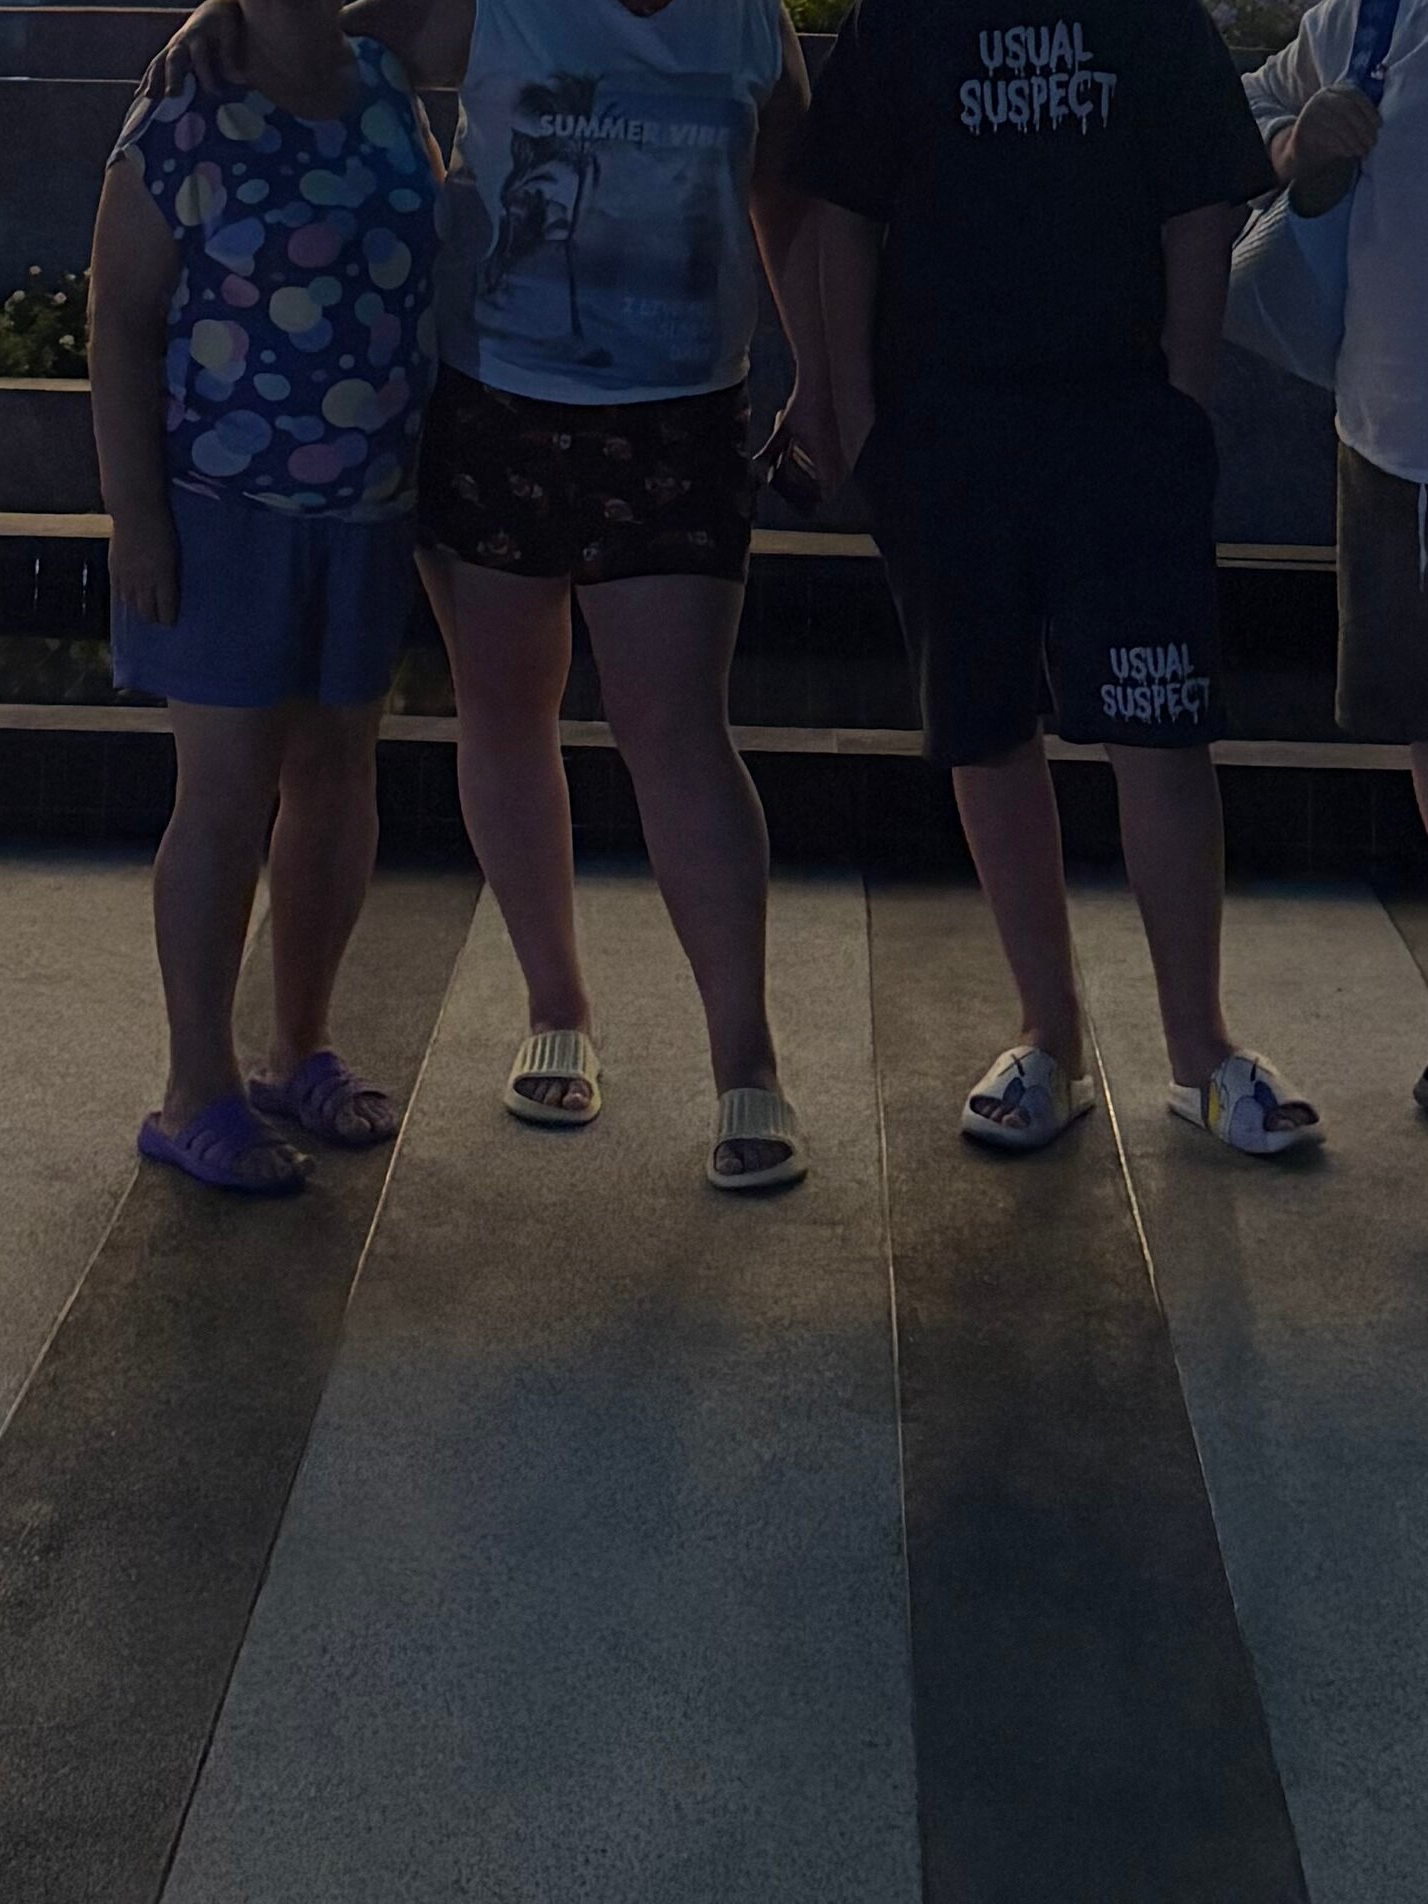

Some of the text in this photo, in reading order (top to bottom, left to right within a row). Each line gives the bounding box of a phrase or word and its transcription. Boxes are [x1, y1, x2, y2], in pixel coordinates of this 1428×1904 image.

[979, 19, 1093, 76] USUAL
[960, 72, 1117, 135] SUSPECT
[539, 113, 660, 145] SUMMER
[1110, 643, 1194, 683] USUAL
[1101, 677, 1210, 724] SUSPECT
